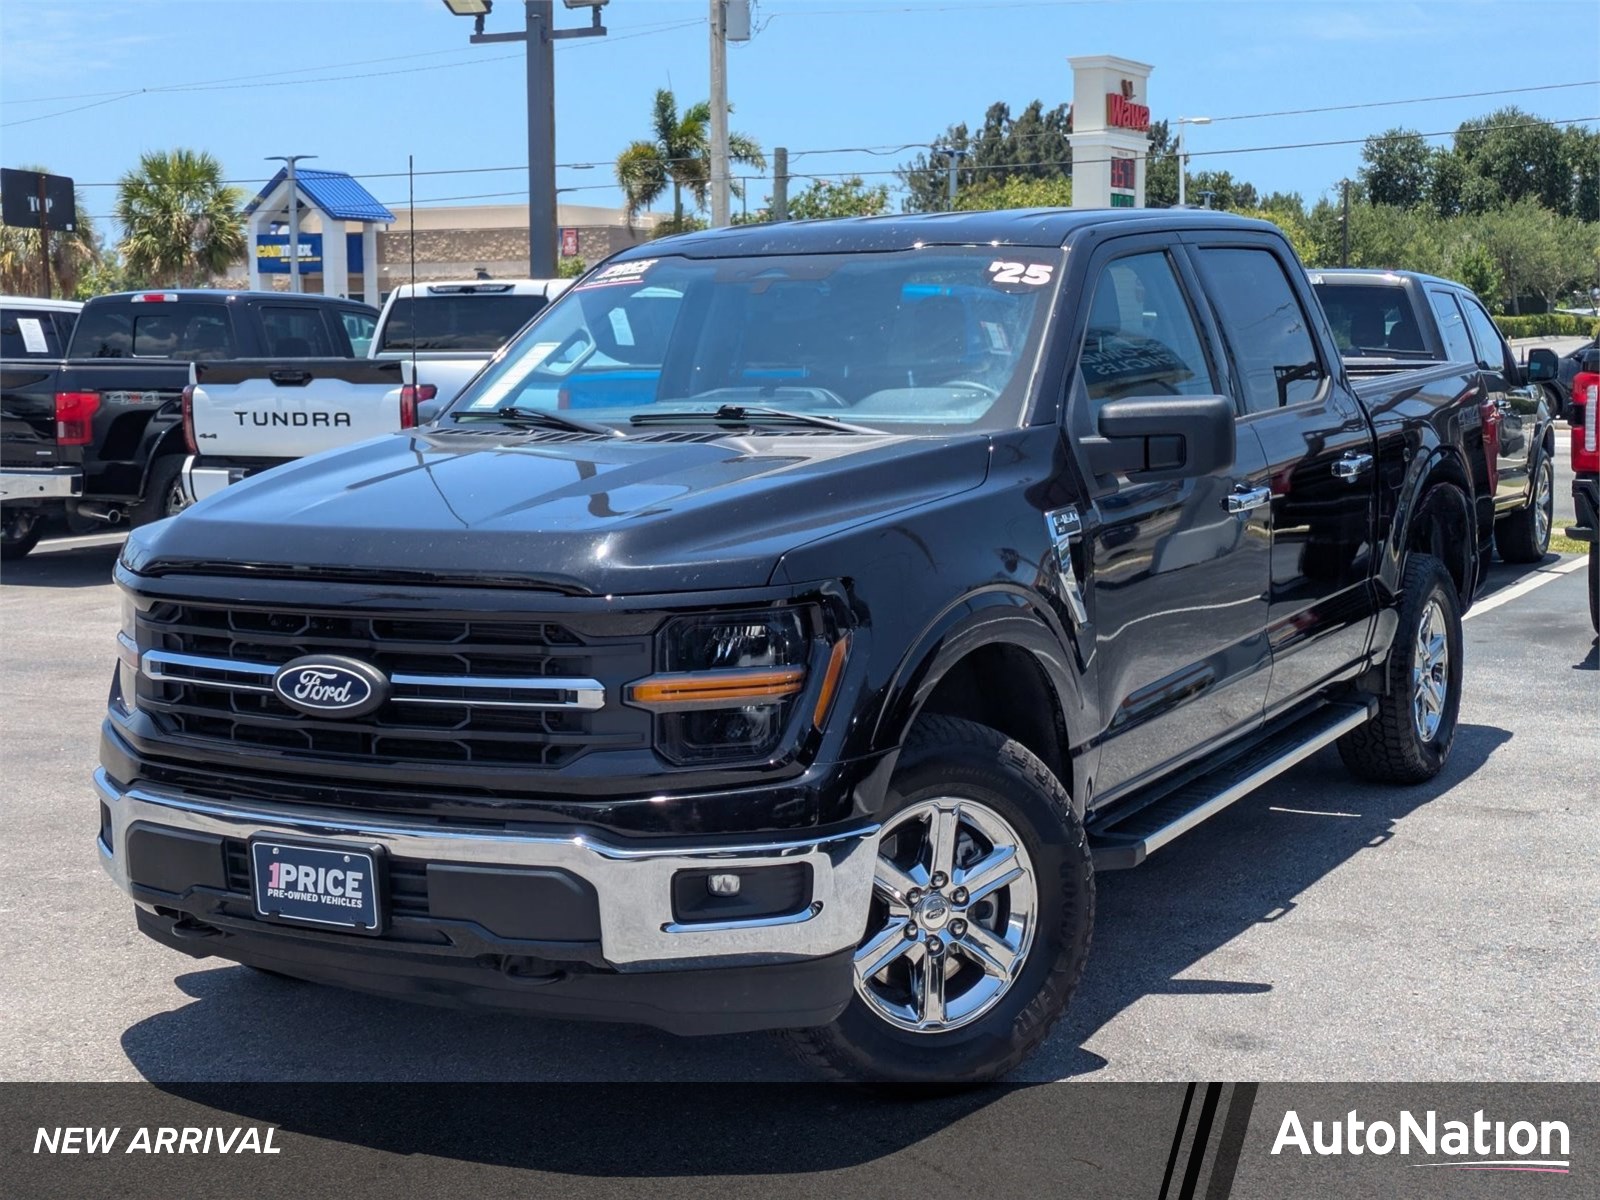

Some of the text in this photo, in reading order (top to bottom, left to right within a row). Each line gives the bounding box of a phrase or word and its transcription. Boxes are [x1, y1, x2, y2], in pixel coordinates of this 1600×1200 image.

[1107, 94, 1150, 131] Wawa
[989, 261, 1053, 285] '25
[234, 411, 352, 427] TUNDRA
[294, 670, 352, 703] Ford
[268, 862, 363, 899] 1PRICE
[267, 888, 363, 909] PRE-OWNED VEHICLES
